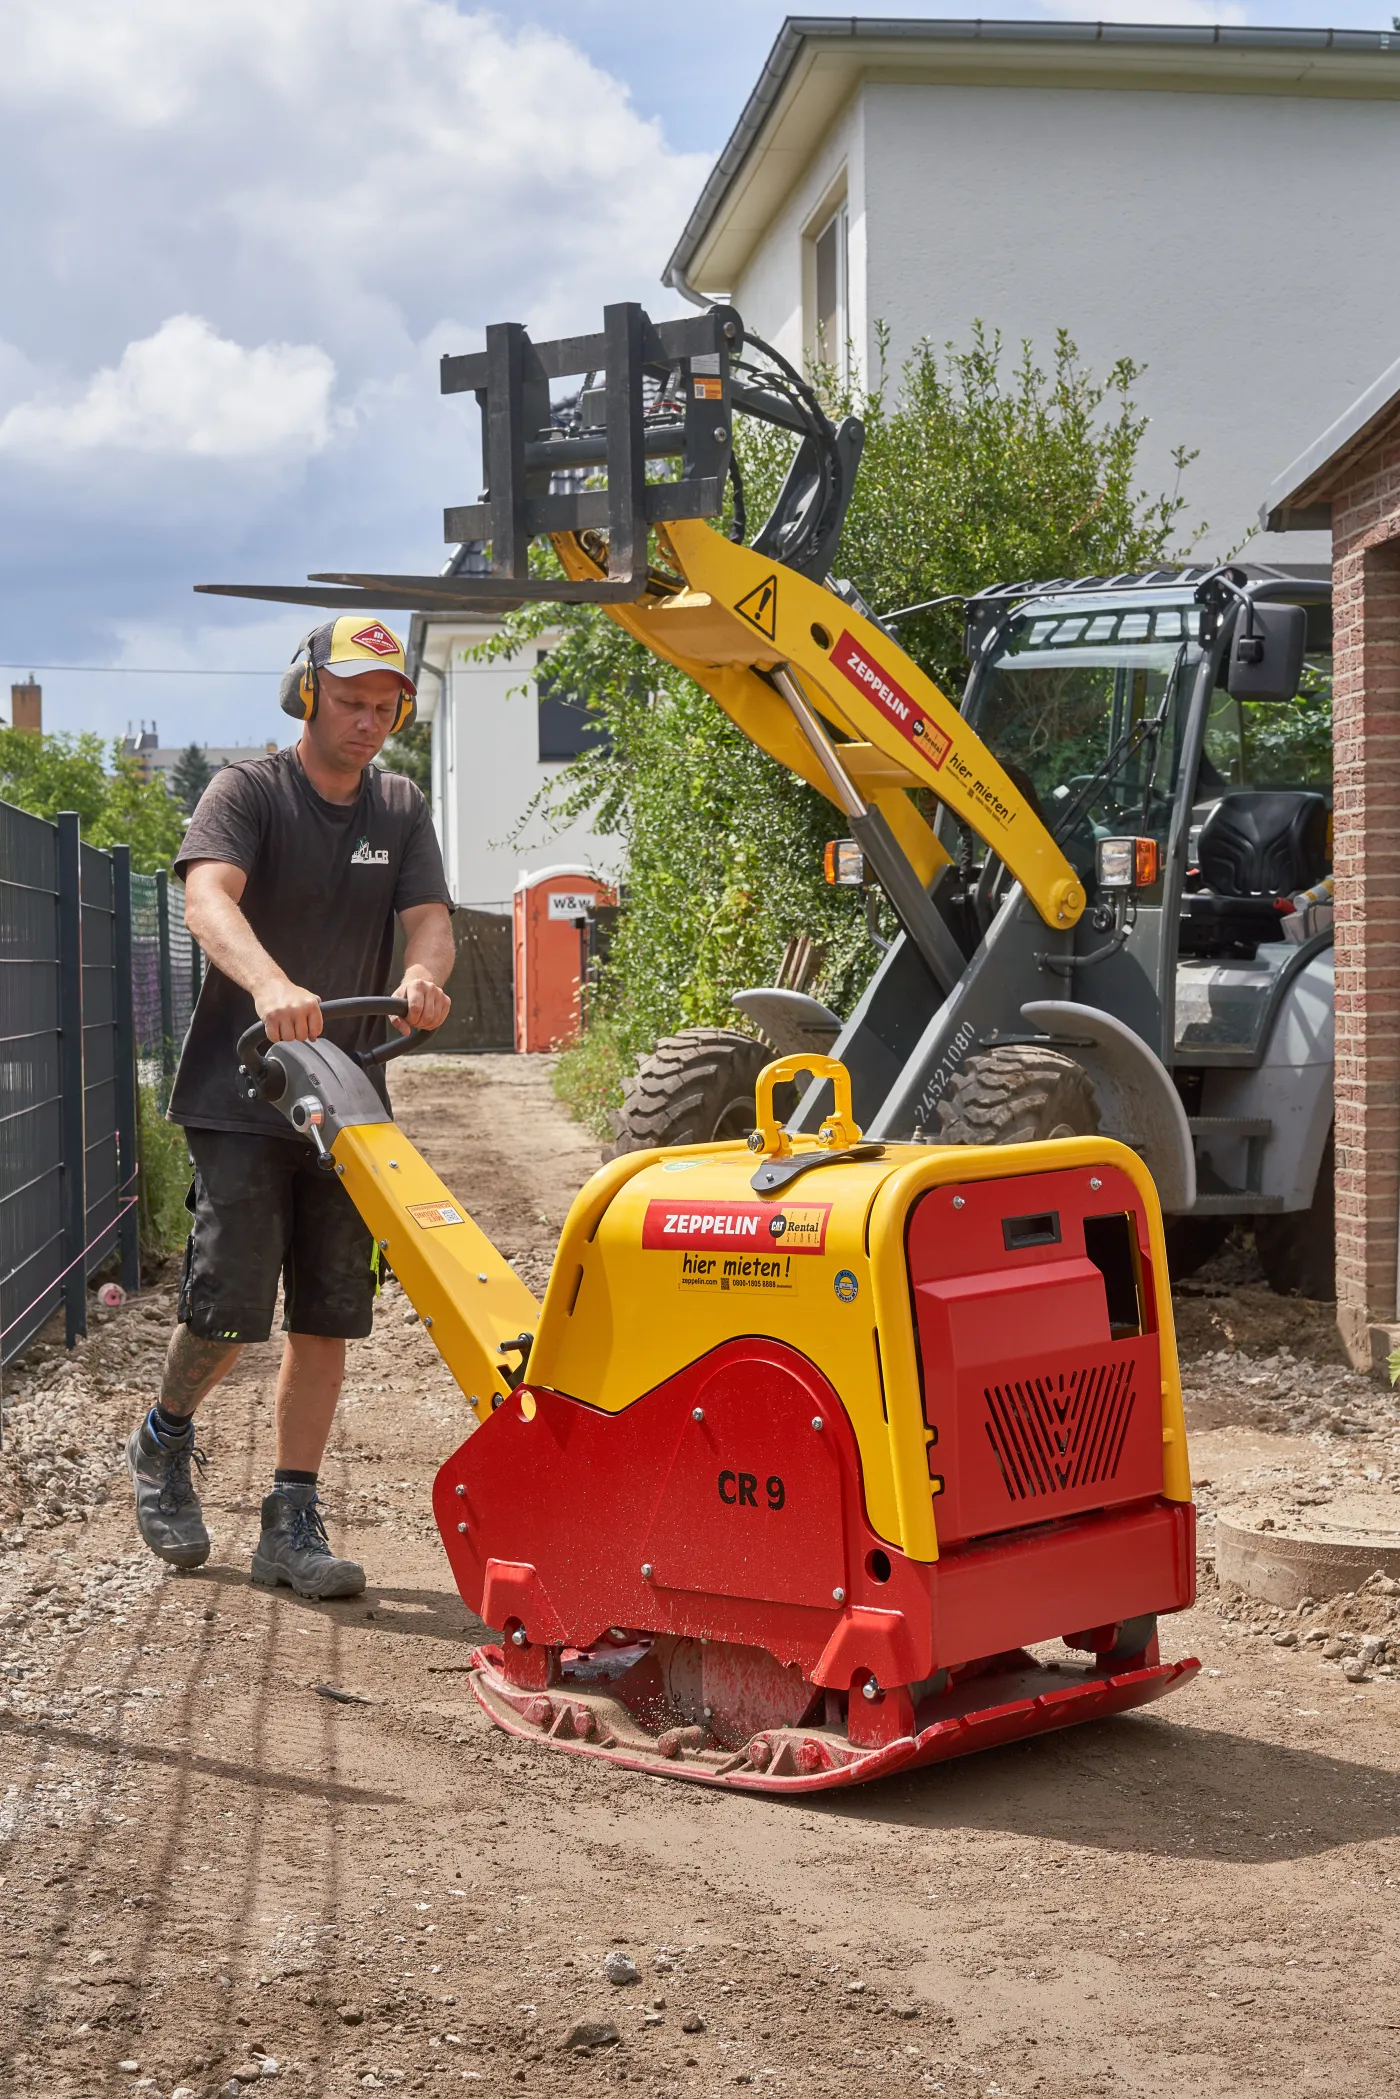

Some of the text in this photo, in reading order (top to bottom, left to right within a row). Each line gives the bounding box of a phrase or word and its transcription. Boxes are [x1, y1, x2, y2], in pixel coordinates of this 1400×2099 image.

[847, 652, 910, 721] ZEPPELIN
[949, 752, 973, 778] hier
[973, 780, 1009, 819] mieten
[663, 1214, 760, 1235] ZEPPELIN
[771, 1220, 785, 1232] CAT
[787, 1221, 820, 1232] Rental
[682, 1252, 717, 1274] hier
[723, 1255, 781, 1277] mieten
[681, 1277, 718, 1286] zeppelin.com
[732, 1279, 761, 1287] 0800-1805
[717, 1469, 785, 1511] CR 9
